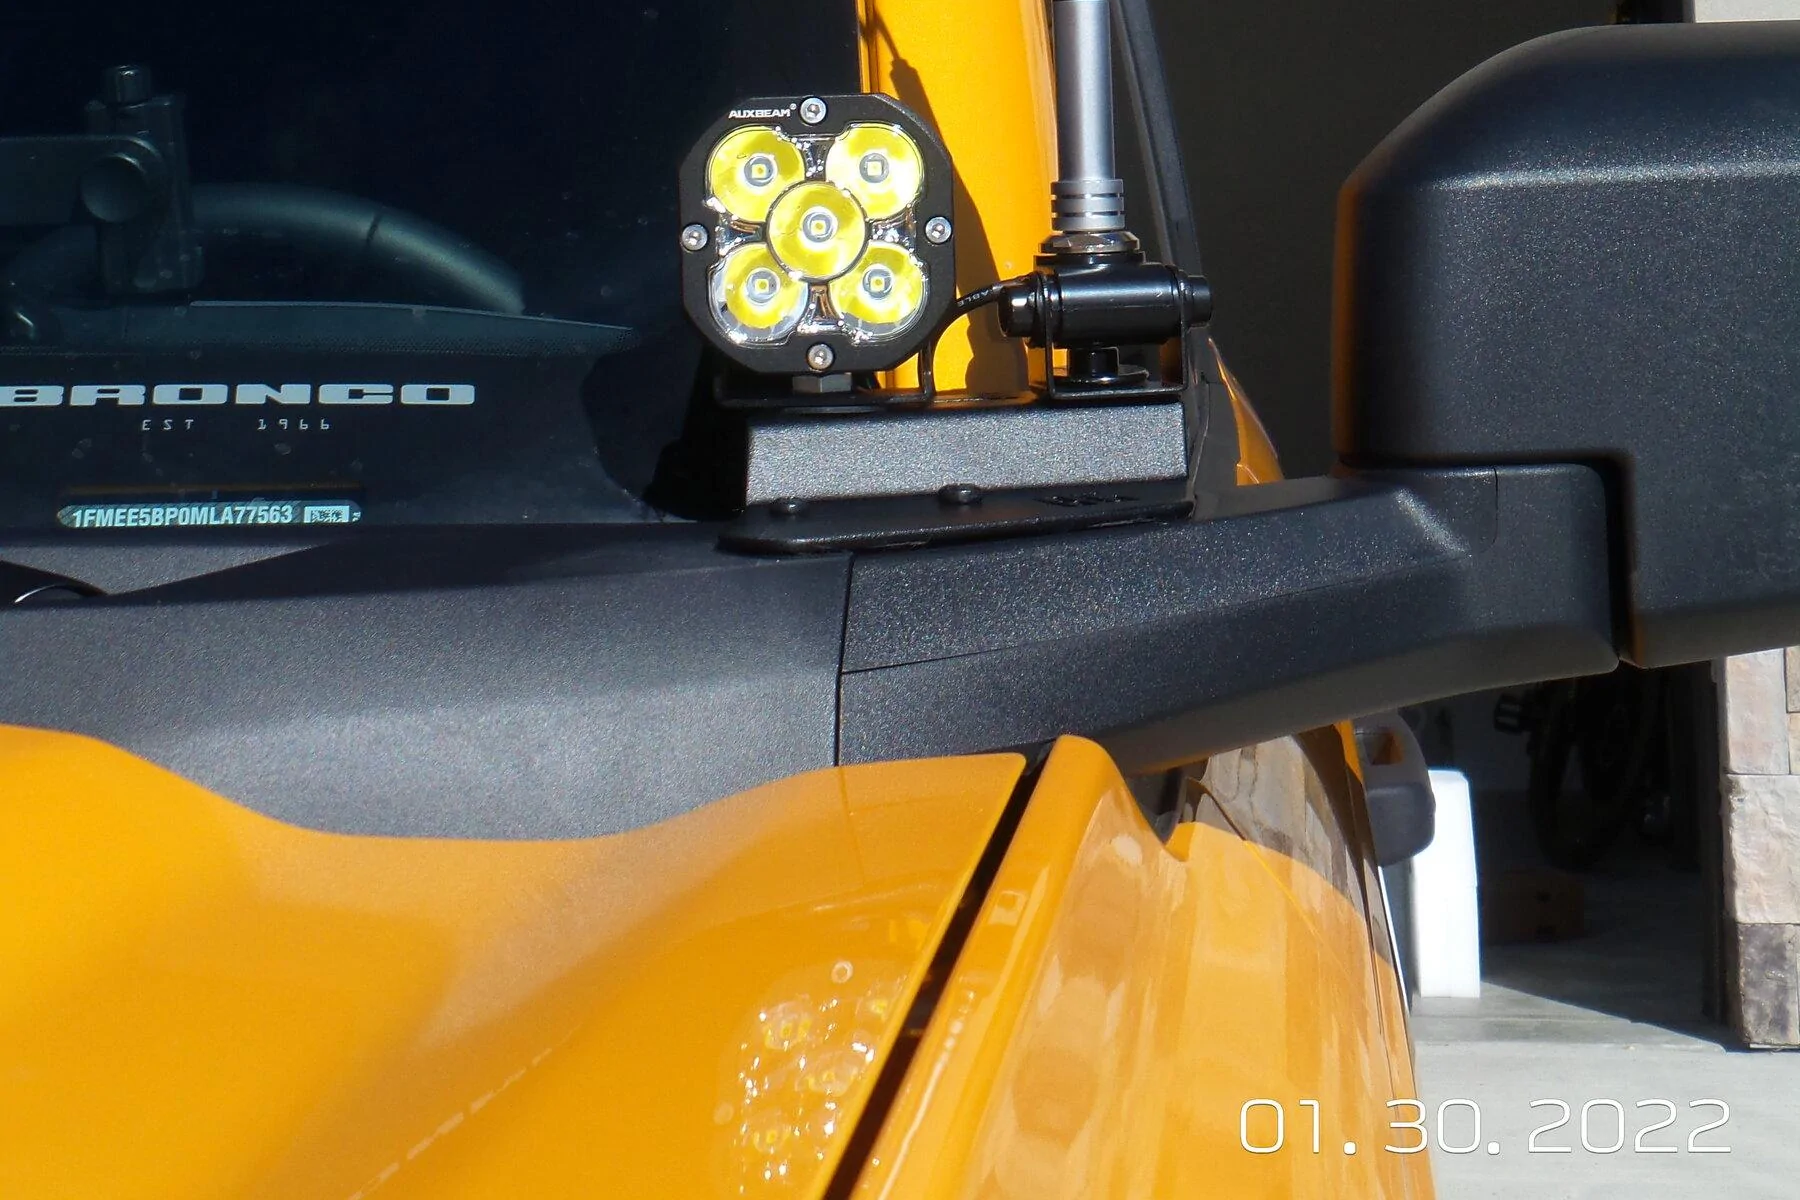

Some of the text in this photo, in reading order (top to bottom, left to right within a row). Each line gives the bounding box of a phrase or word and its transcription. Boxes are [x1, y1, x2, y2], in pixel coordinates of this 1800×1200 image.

[0, 384, 475, 406] BRONCO
[141, 418, 331, 431] EST 1966
[72, 505, 293, 527] 1FMEE5BP0MLA77563
